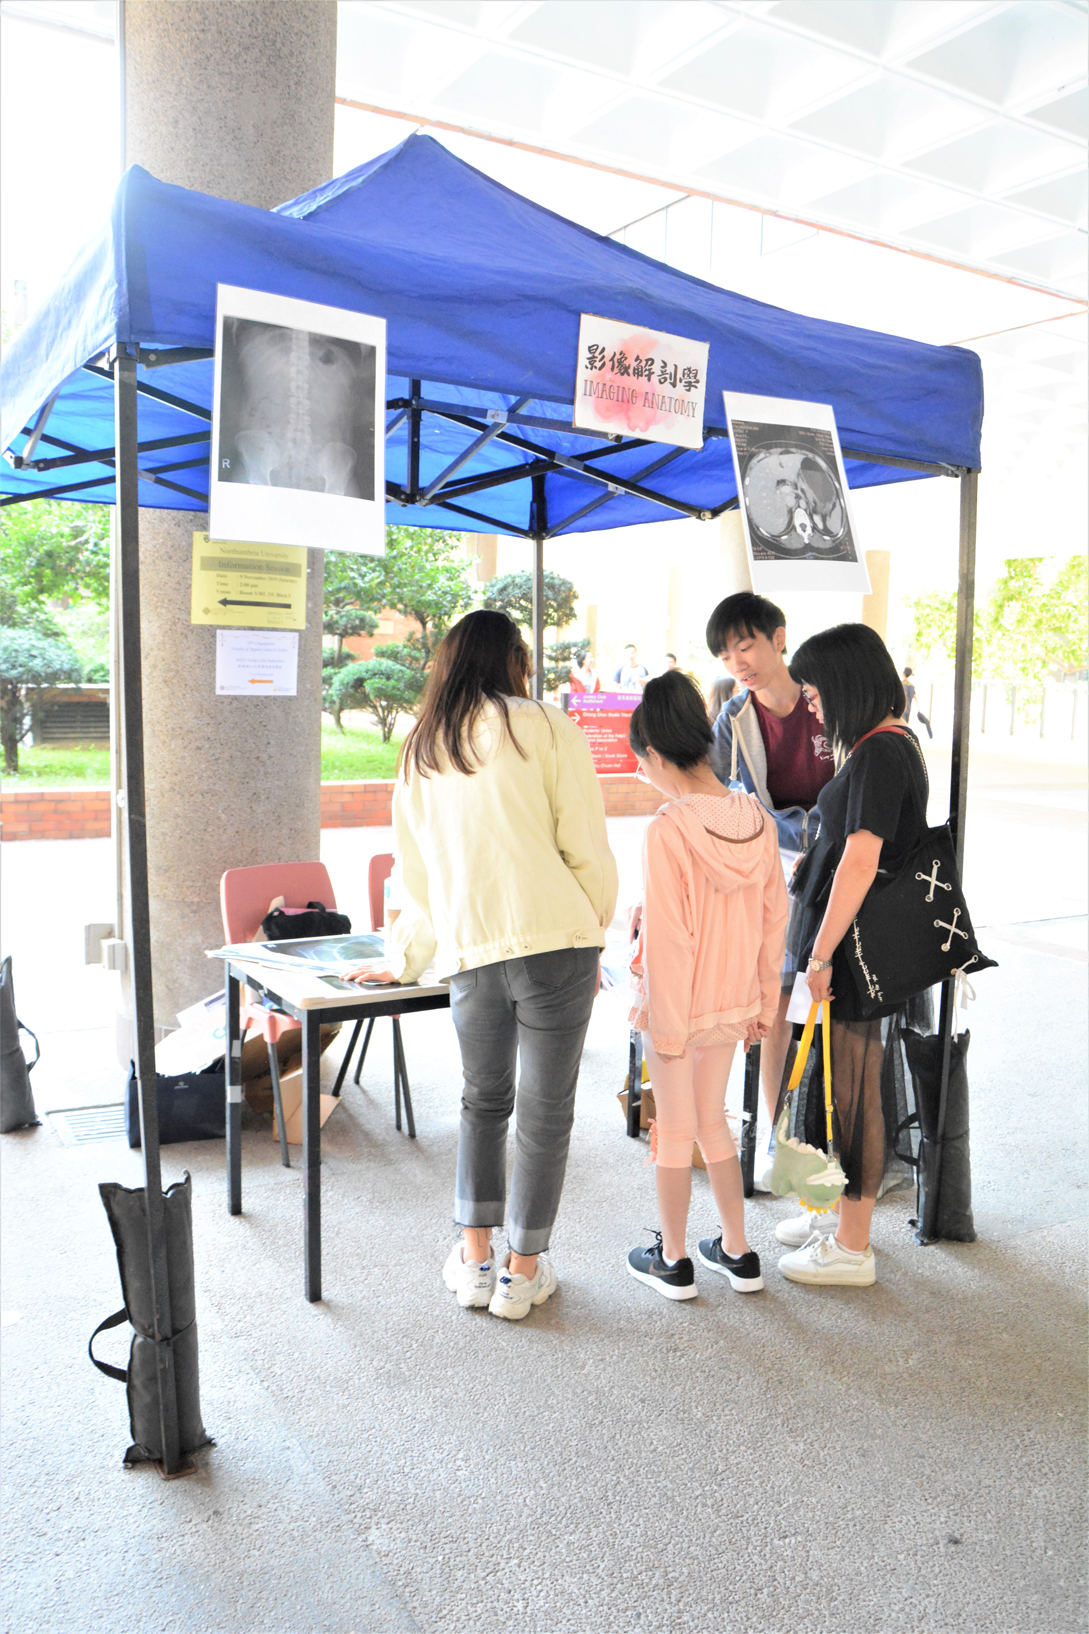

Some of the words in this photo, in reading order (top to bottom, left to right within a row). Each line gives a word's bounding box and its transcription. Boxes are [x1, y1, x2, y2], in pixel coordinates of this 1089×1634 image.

[585, 343, 700, 393] 影像解剖學
[583, 379, 638, 405] IMAGING
[642, 391, 698, 418] ANATOMY
[222, 458, 230, 469] R
[220, 548, 260, 556] Northumbria
[260, 550, 289, 560] University
[218, 560, 264, 570] Information
[265, 564, 291, 573] Session
